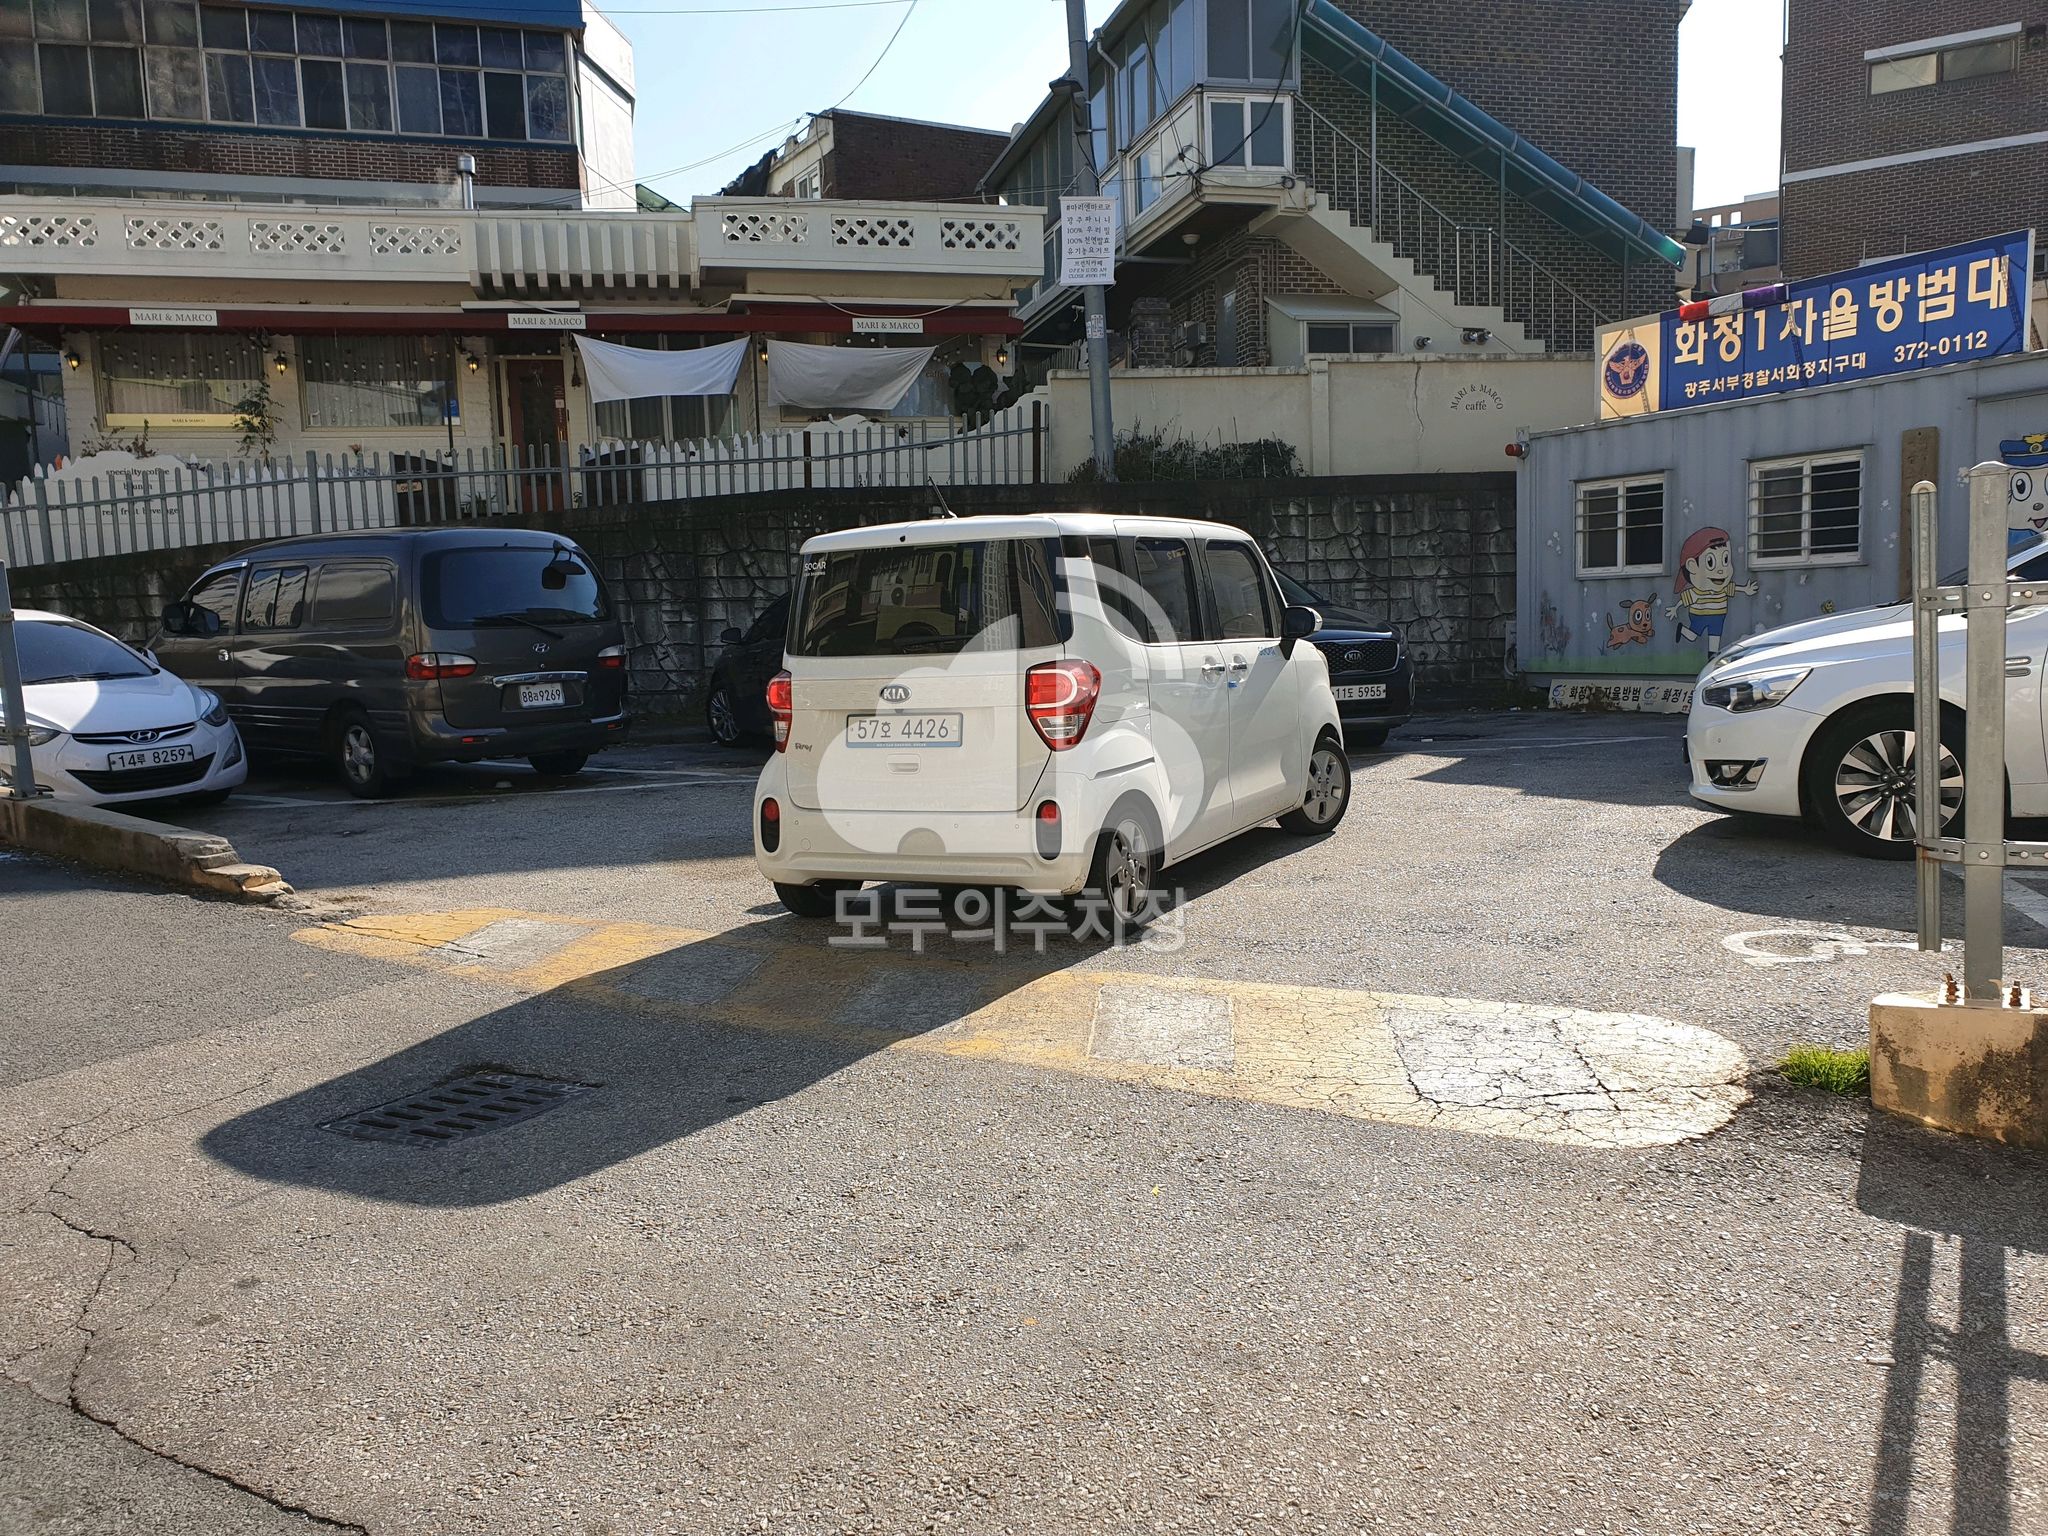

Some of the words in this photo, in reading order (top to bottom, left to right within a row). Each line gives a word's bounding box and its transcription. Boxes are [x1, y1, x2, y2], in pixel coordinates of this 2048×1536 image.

[1779, 254, 2010, 346] 자율방범대
[135, 313, 162, 321] MARI
[165, 313, 173, 321] &
[175, 313, 213, 322] MARCO
[512, 317, 537, 325] MARI
[549, 318, 582, 326] MARCO
[856, 321, 879, 329] MARI
[881, 321, 888, 329] &
[889, 321, 920, 330] MARCO
[1894, 330, 1988, 363] 372-0112
[1450, 387, 1468, 411] MARI
[1470, 384, 1476, 392] &
[1479, 384, 1504, 410] MARCO
[123, 482, 153, 490] bunh
[120, 507, 139, 515] frt
[804, 561, 827, 571] SOCAR
[883, 688, 907, 700] KIA
[1335, 687, 1354, 699] 11도
[1358, 685, 1382, 698] 5955
[857, 719, 892, 740] 57호
[901, 718, 949, 739] 4426
[152, 748, 186, 764] 8259
